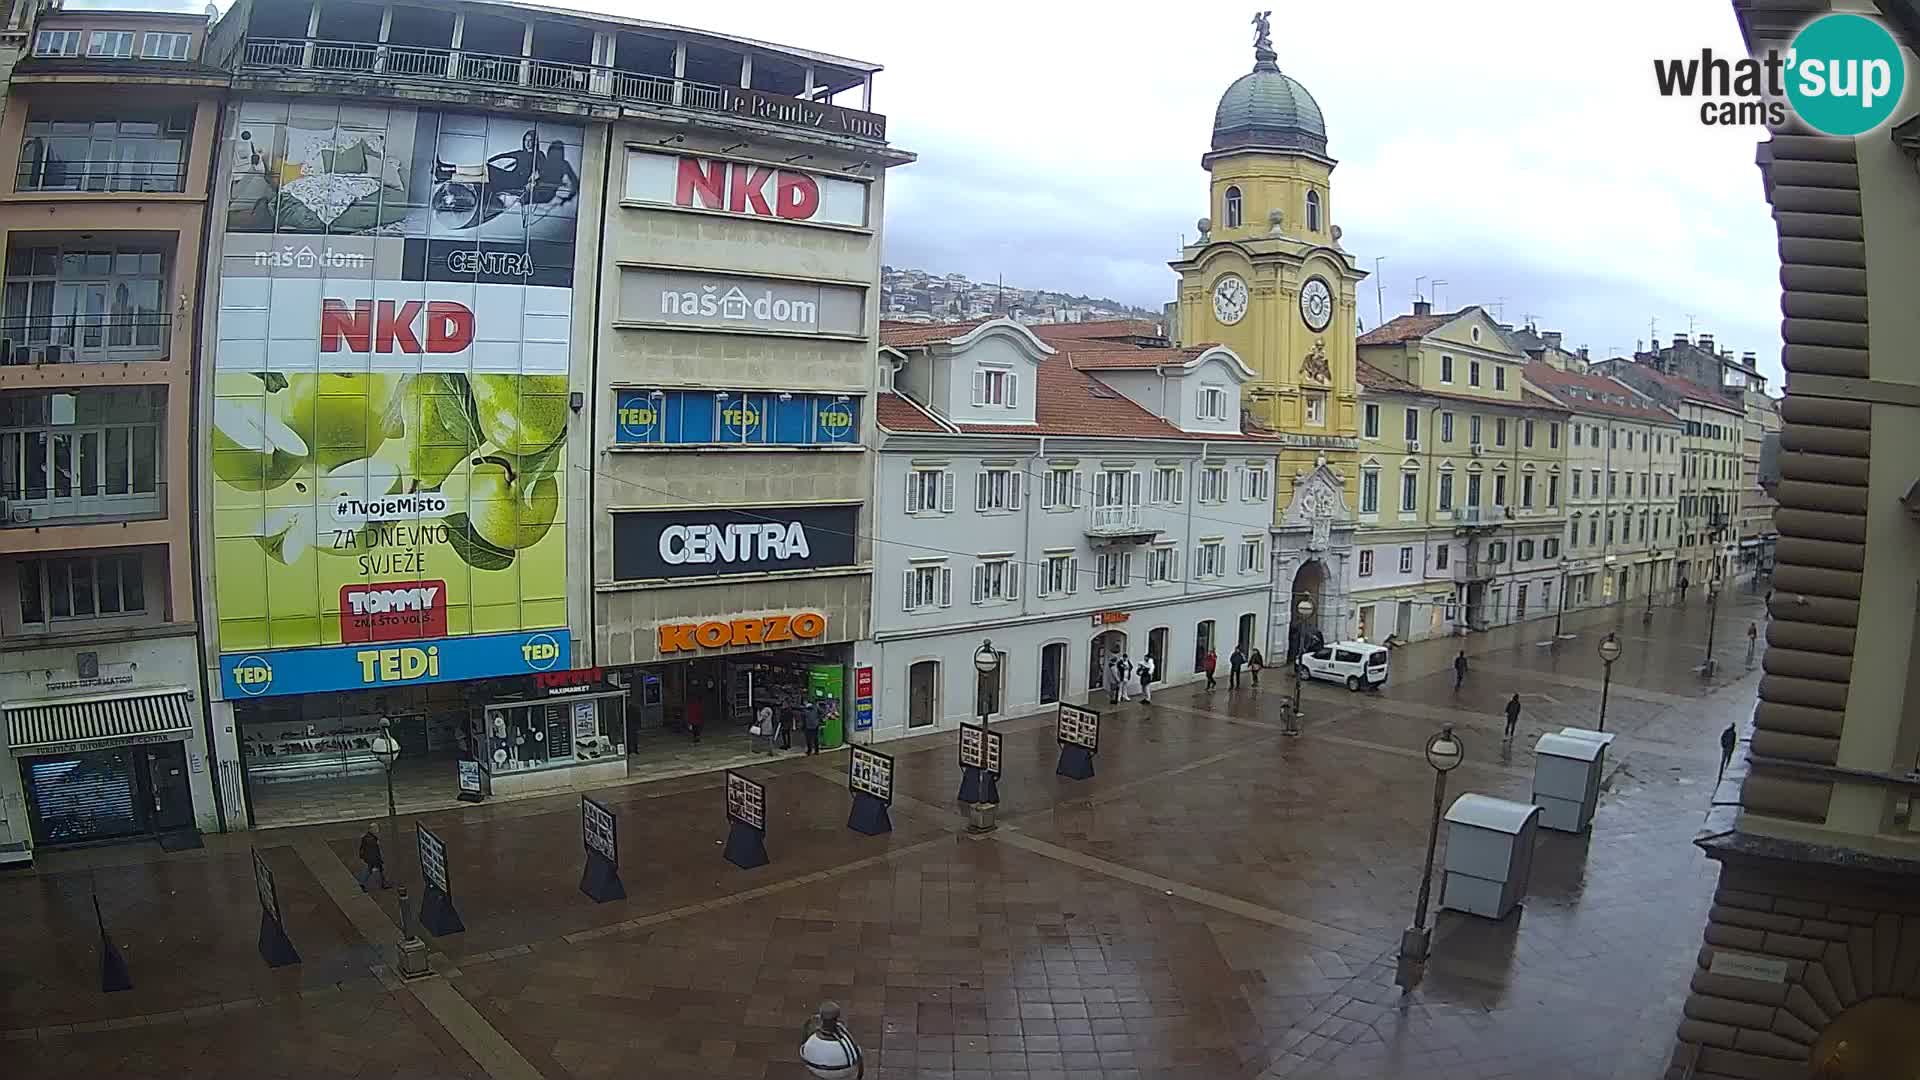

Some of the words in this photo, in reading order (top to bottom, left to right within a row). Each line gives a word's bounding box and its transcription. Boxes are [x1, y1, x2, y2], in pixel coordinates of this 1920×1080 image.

[723, 90, 745, 113] Le
[751, 95, 824, 126] Rendez
[841, 110, 884, 138] Vous
[676, 158, 820, 220] NKD
[254, 246, 292, 268] naš
[319, 248, 365, 270] dom
[448, 250, 536, 276] CENTRA
[661, 285, 719, 317] naš
[753, 291, 817, 324] dom
[321, 298, 477, 354] NKD
[618, 408, 657, 426] TEDi
[722, 409, 760, 426] TEDi
[819, 411, 853, 428] TEDi
[337, 498, 445, 517] #TvojeMisto
[333, 530, 357, 549] ZA
[366, 525, 450, 549] DNEVNO
[659, 521, 810, 565] CENTRA
[359, 548, 426, 575] SVJEŽE
[348, 587, 439, 615] TOMMY
[379, 615, 399, 626] ŠTO
[659, 612, 826, 654] KORZO
[357, 645, 441, 684] TEDi
[521, 642, 560, 662] TEDi
[233, 667, 273, 685] TEDi
[548, 684, 591, 696] MAXIMARKET
